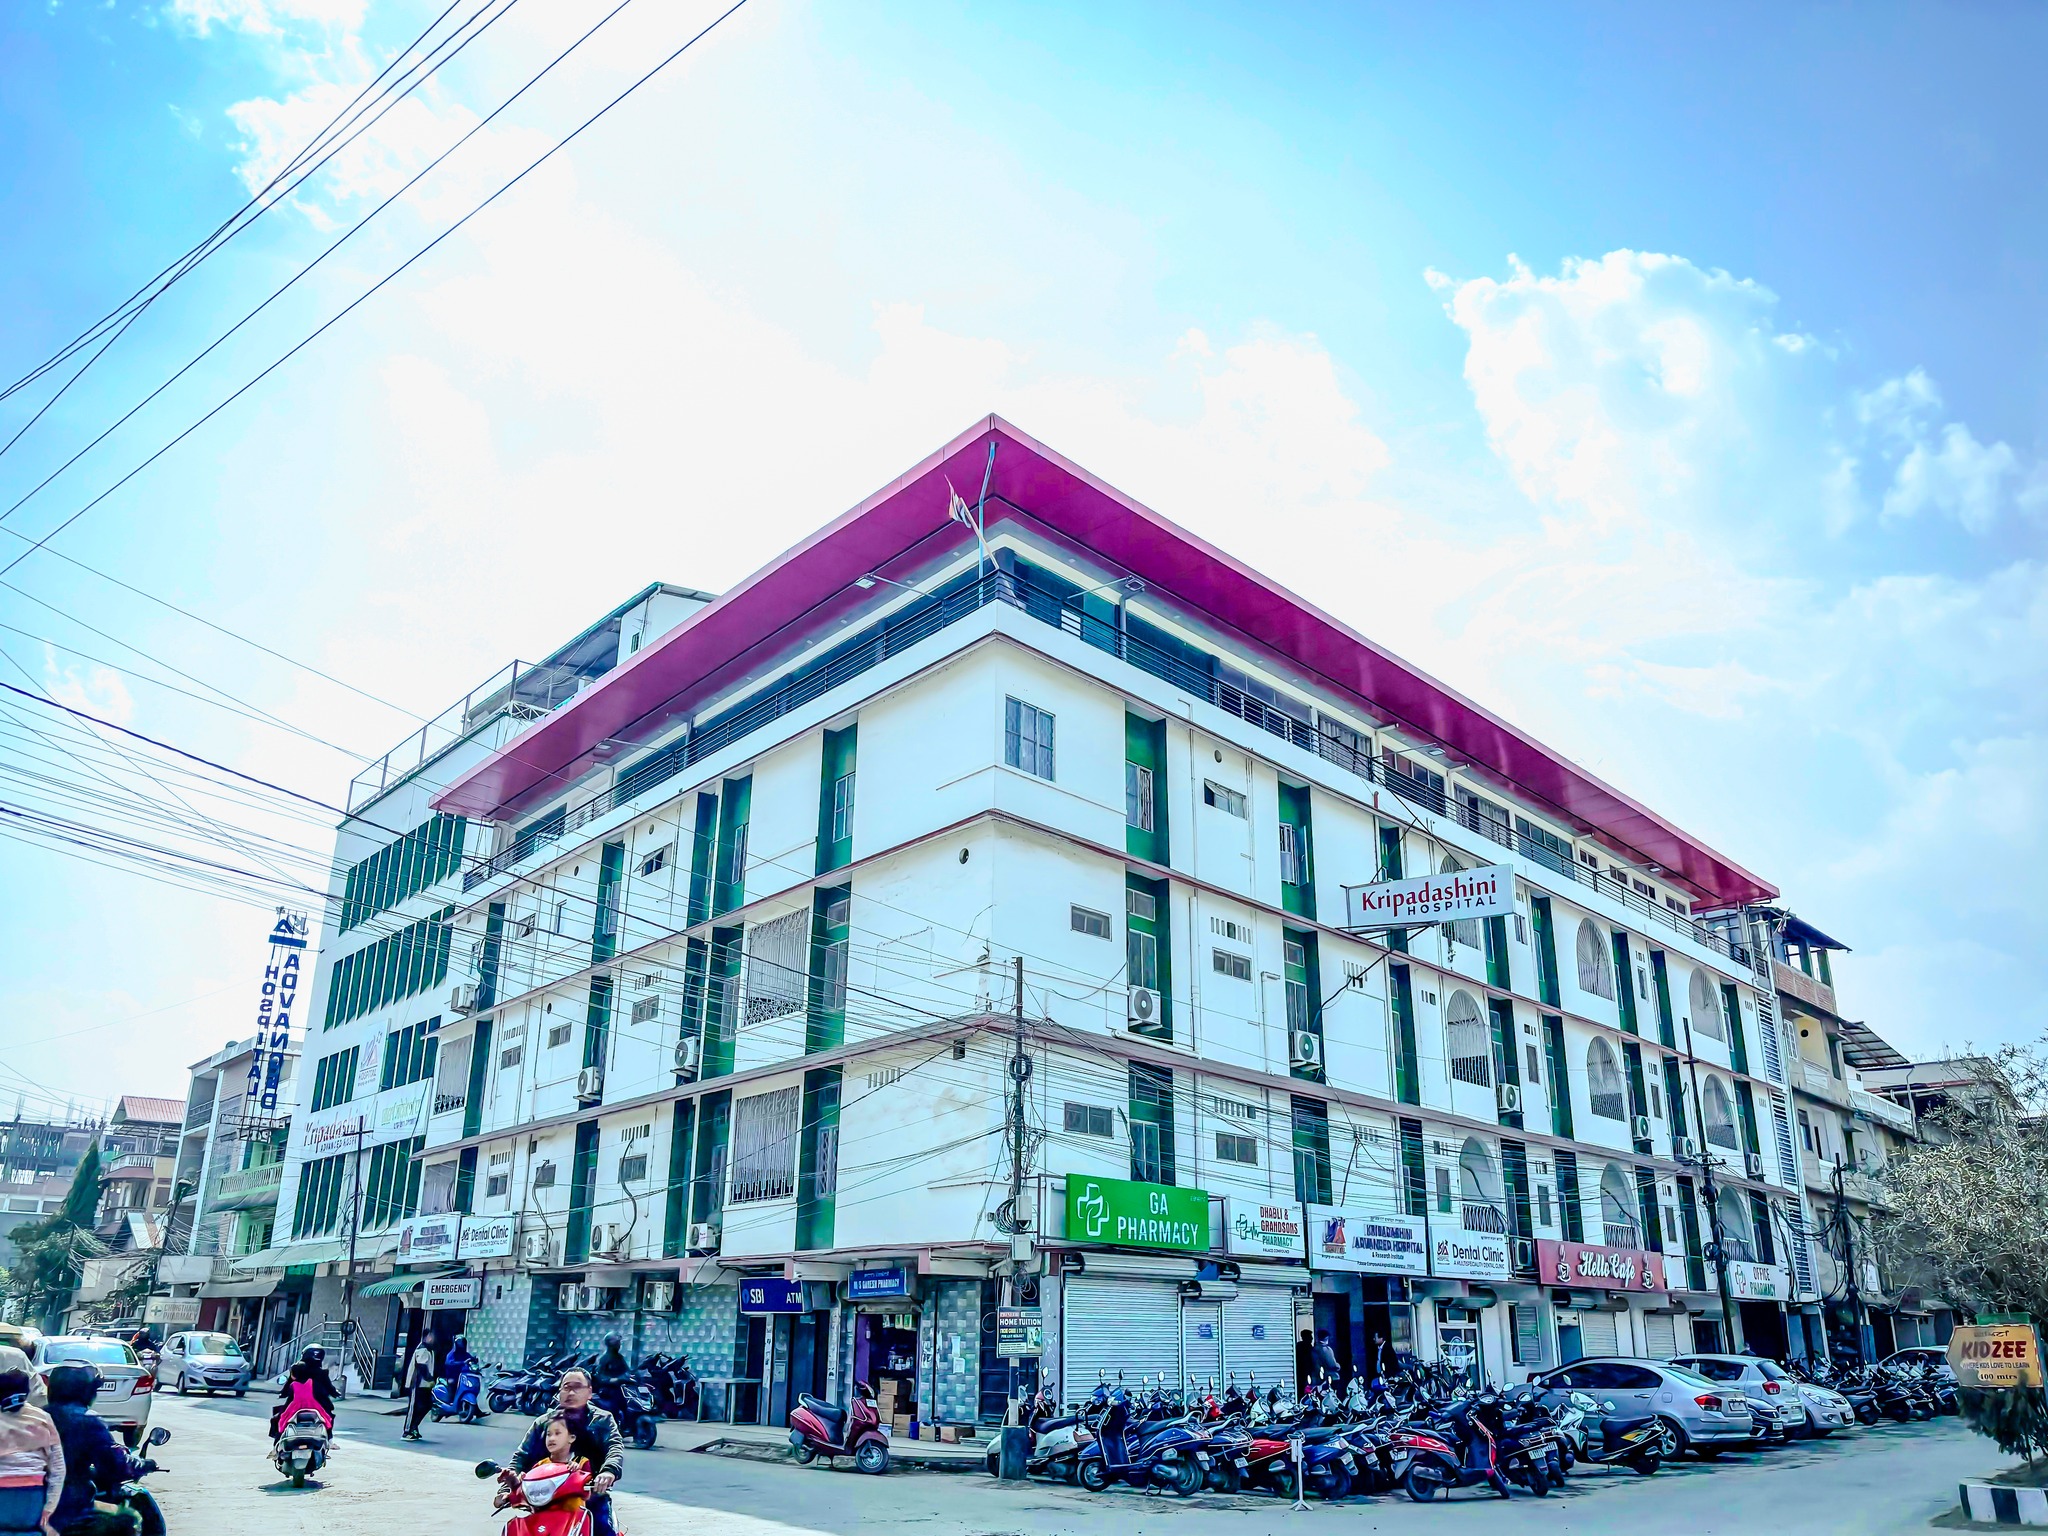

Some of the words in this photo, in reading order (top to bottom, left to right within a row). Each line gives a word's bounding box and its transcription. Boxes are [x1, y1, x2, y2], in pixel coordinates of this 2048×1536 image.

[1362, 873, 1496, 917] Kripadashini
[1408, 895, 1496, 915] HOSPITAL
[1149, 1191, 1169, 1216] GA
[1260, 1206, 1283, 1220] DHABLI
[1283, 1208, 1289, 1220] &
[471, 1227, 491, 1242] Dental
[490, 1224, 509, 1240] Clinic
[1117, 1216, 1199, 1246] PHARMACY
[1261, 1220, 1299, 1235] GRANDSONS
[1262, 1235, 1293, 1247] PHARMACY
[1452, 1243, 1480, 1260] Dental
[1482, 1246, 1504, 1262] Clinic
[1578, 1250, 1611, 1278] Hello
[1609, 1253, 1636, 1288] Cafe
[430, 1283, 472, 1294] EMERGENCY
[750, 1288, 765, 1304] SBI
[786, 1292, 802, 1304] ATM
[999, 1318, 1018, 1326] HOME
[1018, 1318, 1042, 1326] TUITION
[1961, 1341, 2027, 1359] KIDZEE
